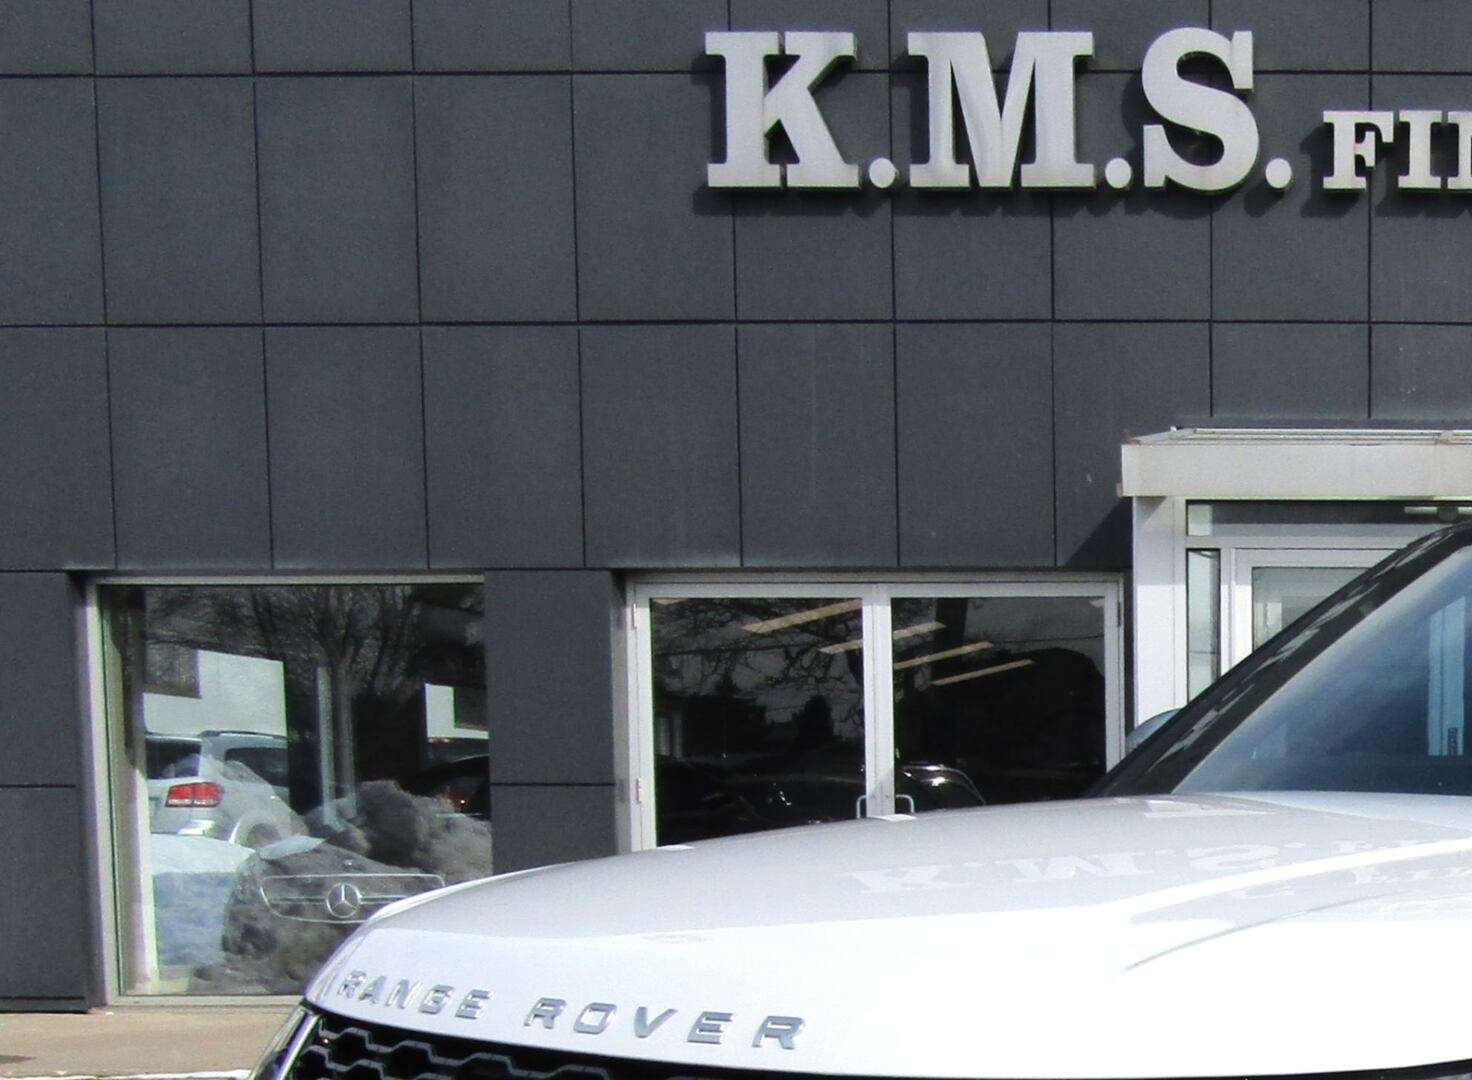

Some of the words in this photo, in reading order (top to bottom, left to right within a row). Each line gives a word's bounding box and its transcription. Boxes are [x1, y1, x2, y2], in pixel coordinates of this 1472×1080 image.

[704, 27, 1293, 191] K.M.S.
[337, 969, 496, 1020] RANGE
[524, 996, 806, 1051] ROVER
